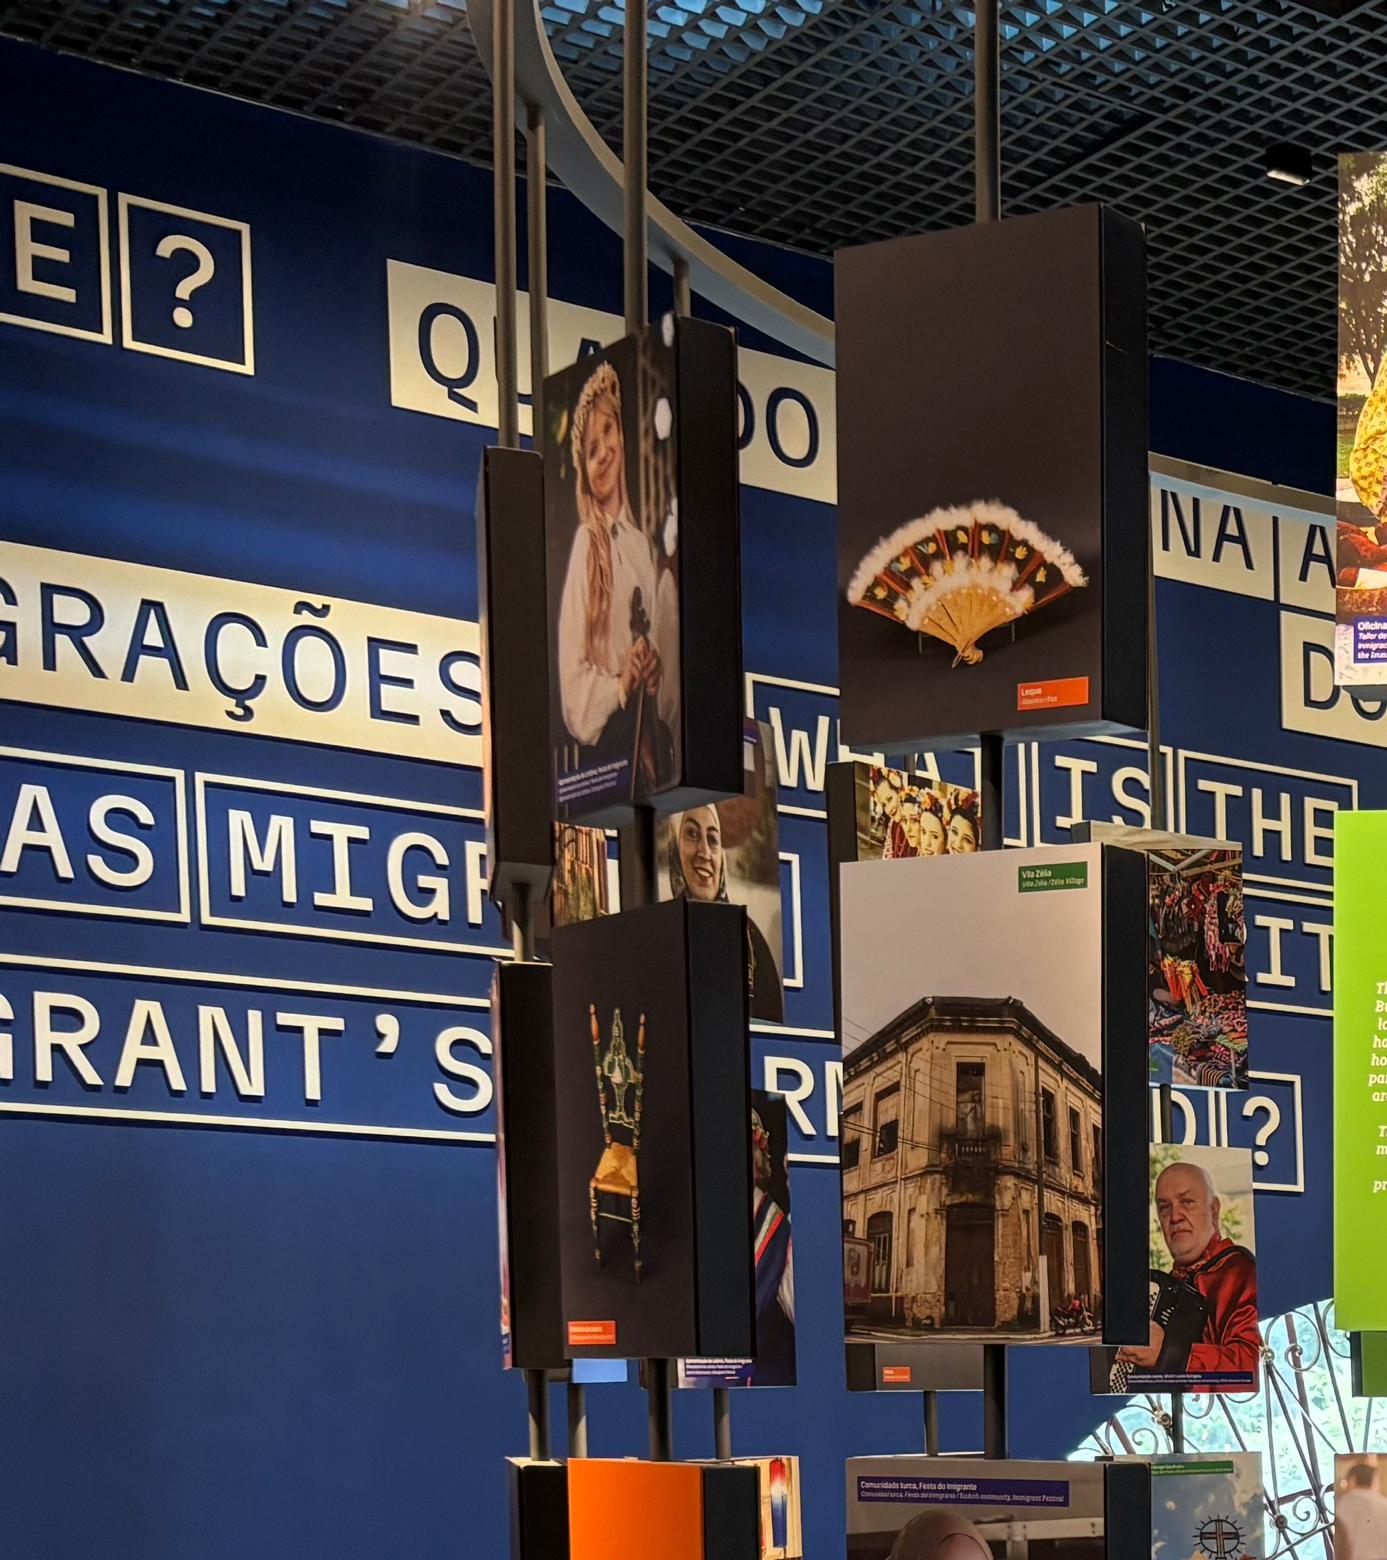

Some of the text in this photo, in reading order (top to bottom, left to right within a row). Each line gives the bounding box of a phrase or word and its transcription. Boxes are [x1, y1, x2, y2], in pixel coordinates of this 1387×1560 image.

[14, 200, 215, 328] E ?
[0, 575, 484, 736] RAÇÕES
[1303, 641, 1387, 722] D
[1197, 779, 1339, 868] THE
[0, 991, 494, 1114] RANT'S
